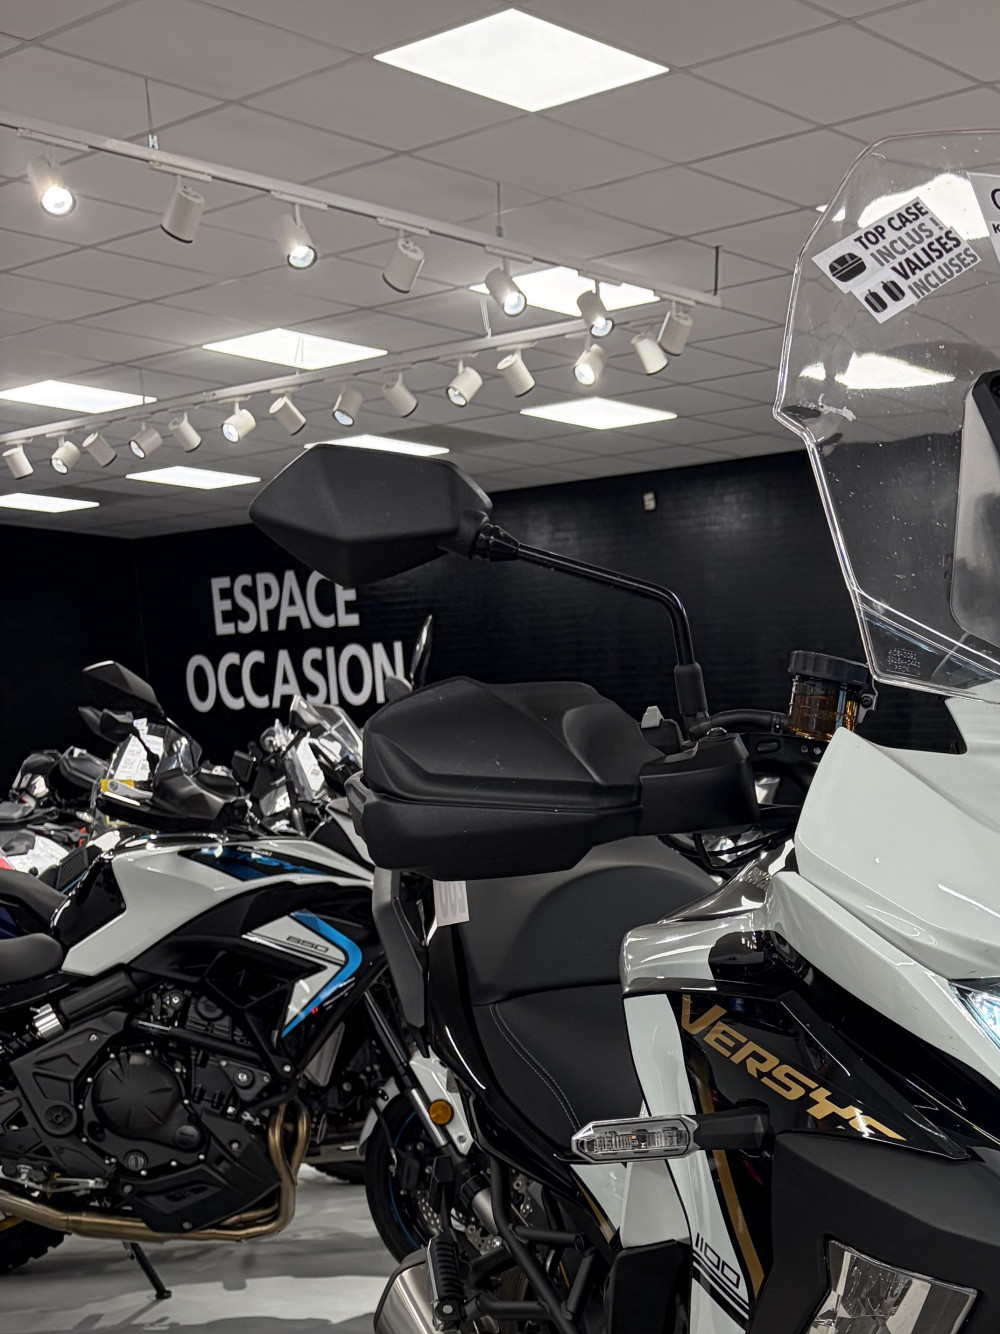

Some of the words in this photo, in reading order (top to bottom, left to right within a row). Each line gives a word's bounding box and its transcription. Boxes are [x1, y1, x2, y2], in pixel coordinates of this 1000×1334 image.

[854, 224, 886, 251] TOP
[887, 202, 929, 232] CASE
[870, 222, 934, 267] INCLUS
[930, 217, 943, 230] !
[890, 229, 962, 281] VALISES
[907, 248, 978, 299] INCLUSES
[211, 569, 360, 636] ESPACE
[185, 640, 405, 713] OCCASION
[695, 1232, 741, 1289] 1100
